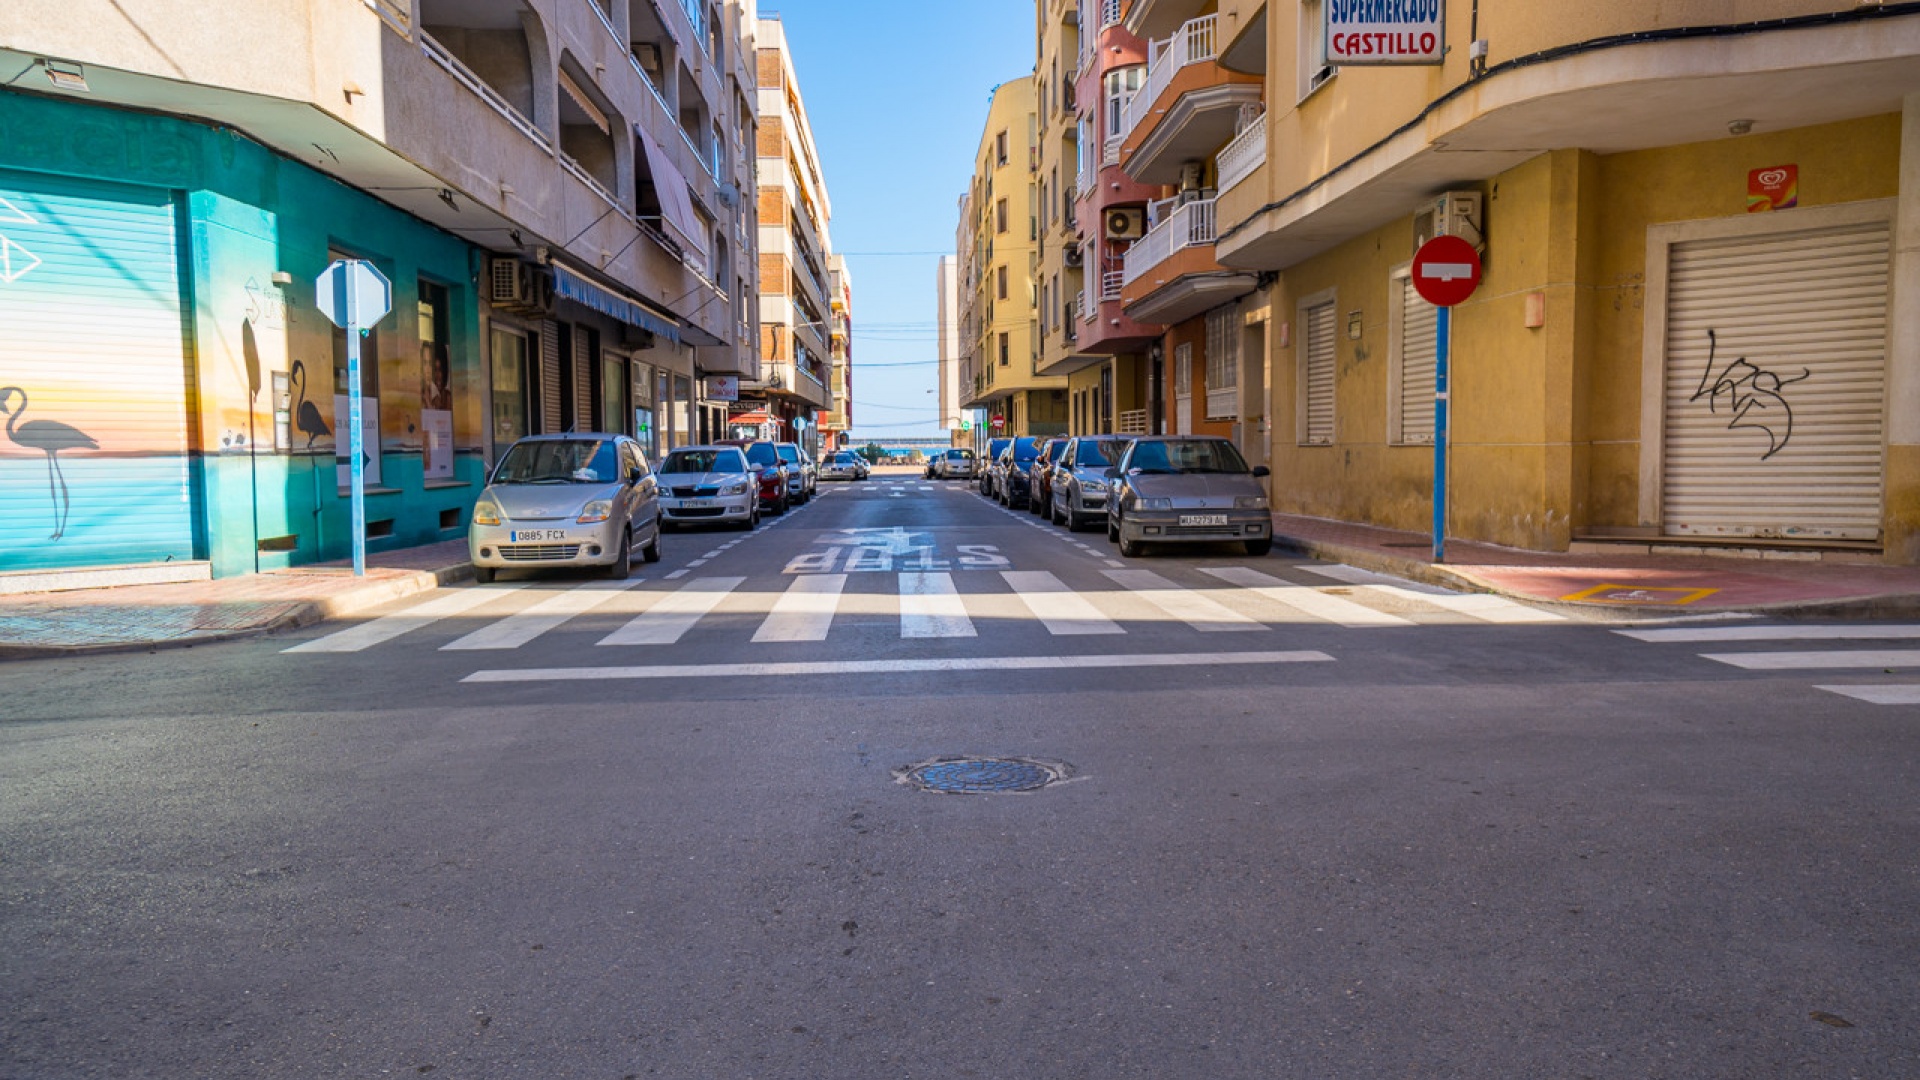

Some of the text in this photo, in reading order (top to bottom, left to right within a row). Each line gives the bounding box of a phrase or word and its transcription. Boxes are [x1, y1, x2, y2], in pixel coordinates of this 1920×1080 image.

[1331, 0, 1438, 23] SUPERMERCADO
[1332, 32, 1436, 56] CASTILLO
[518, 530, 565, 541] 0885 FCX
[781, 545, 1012, 574] STOP
